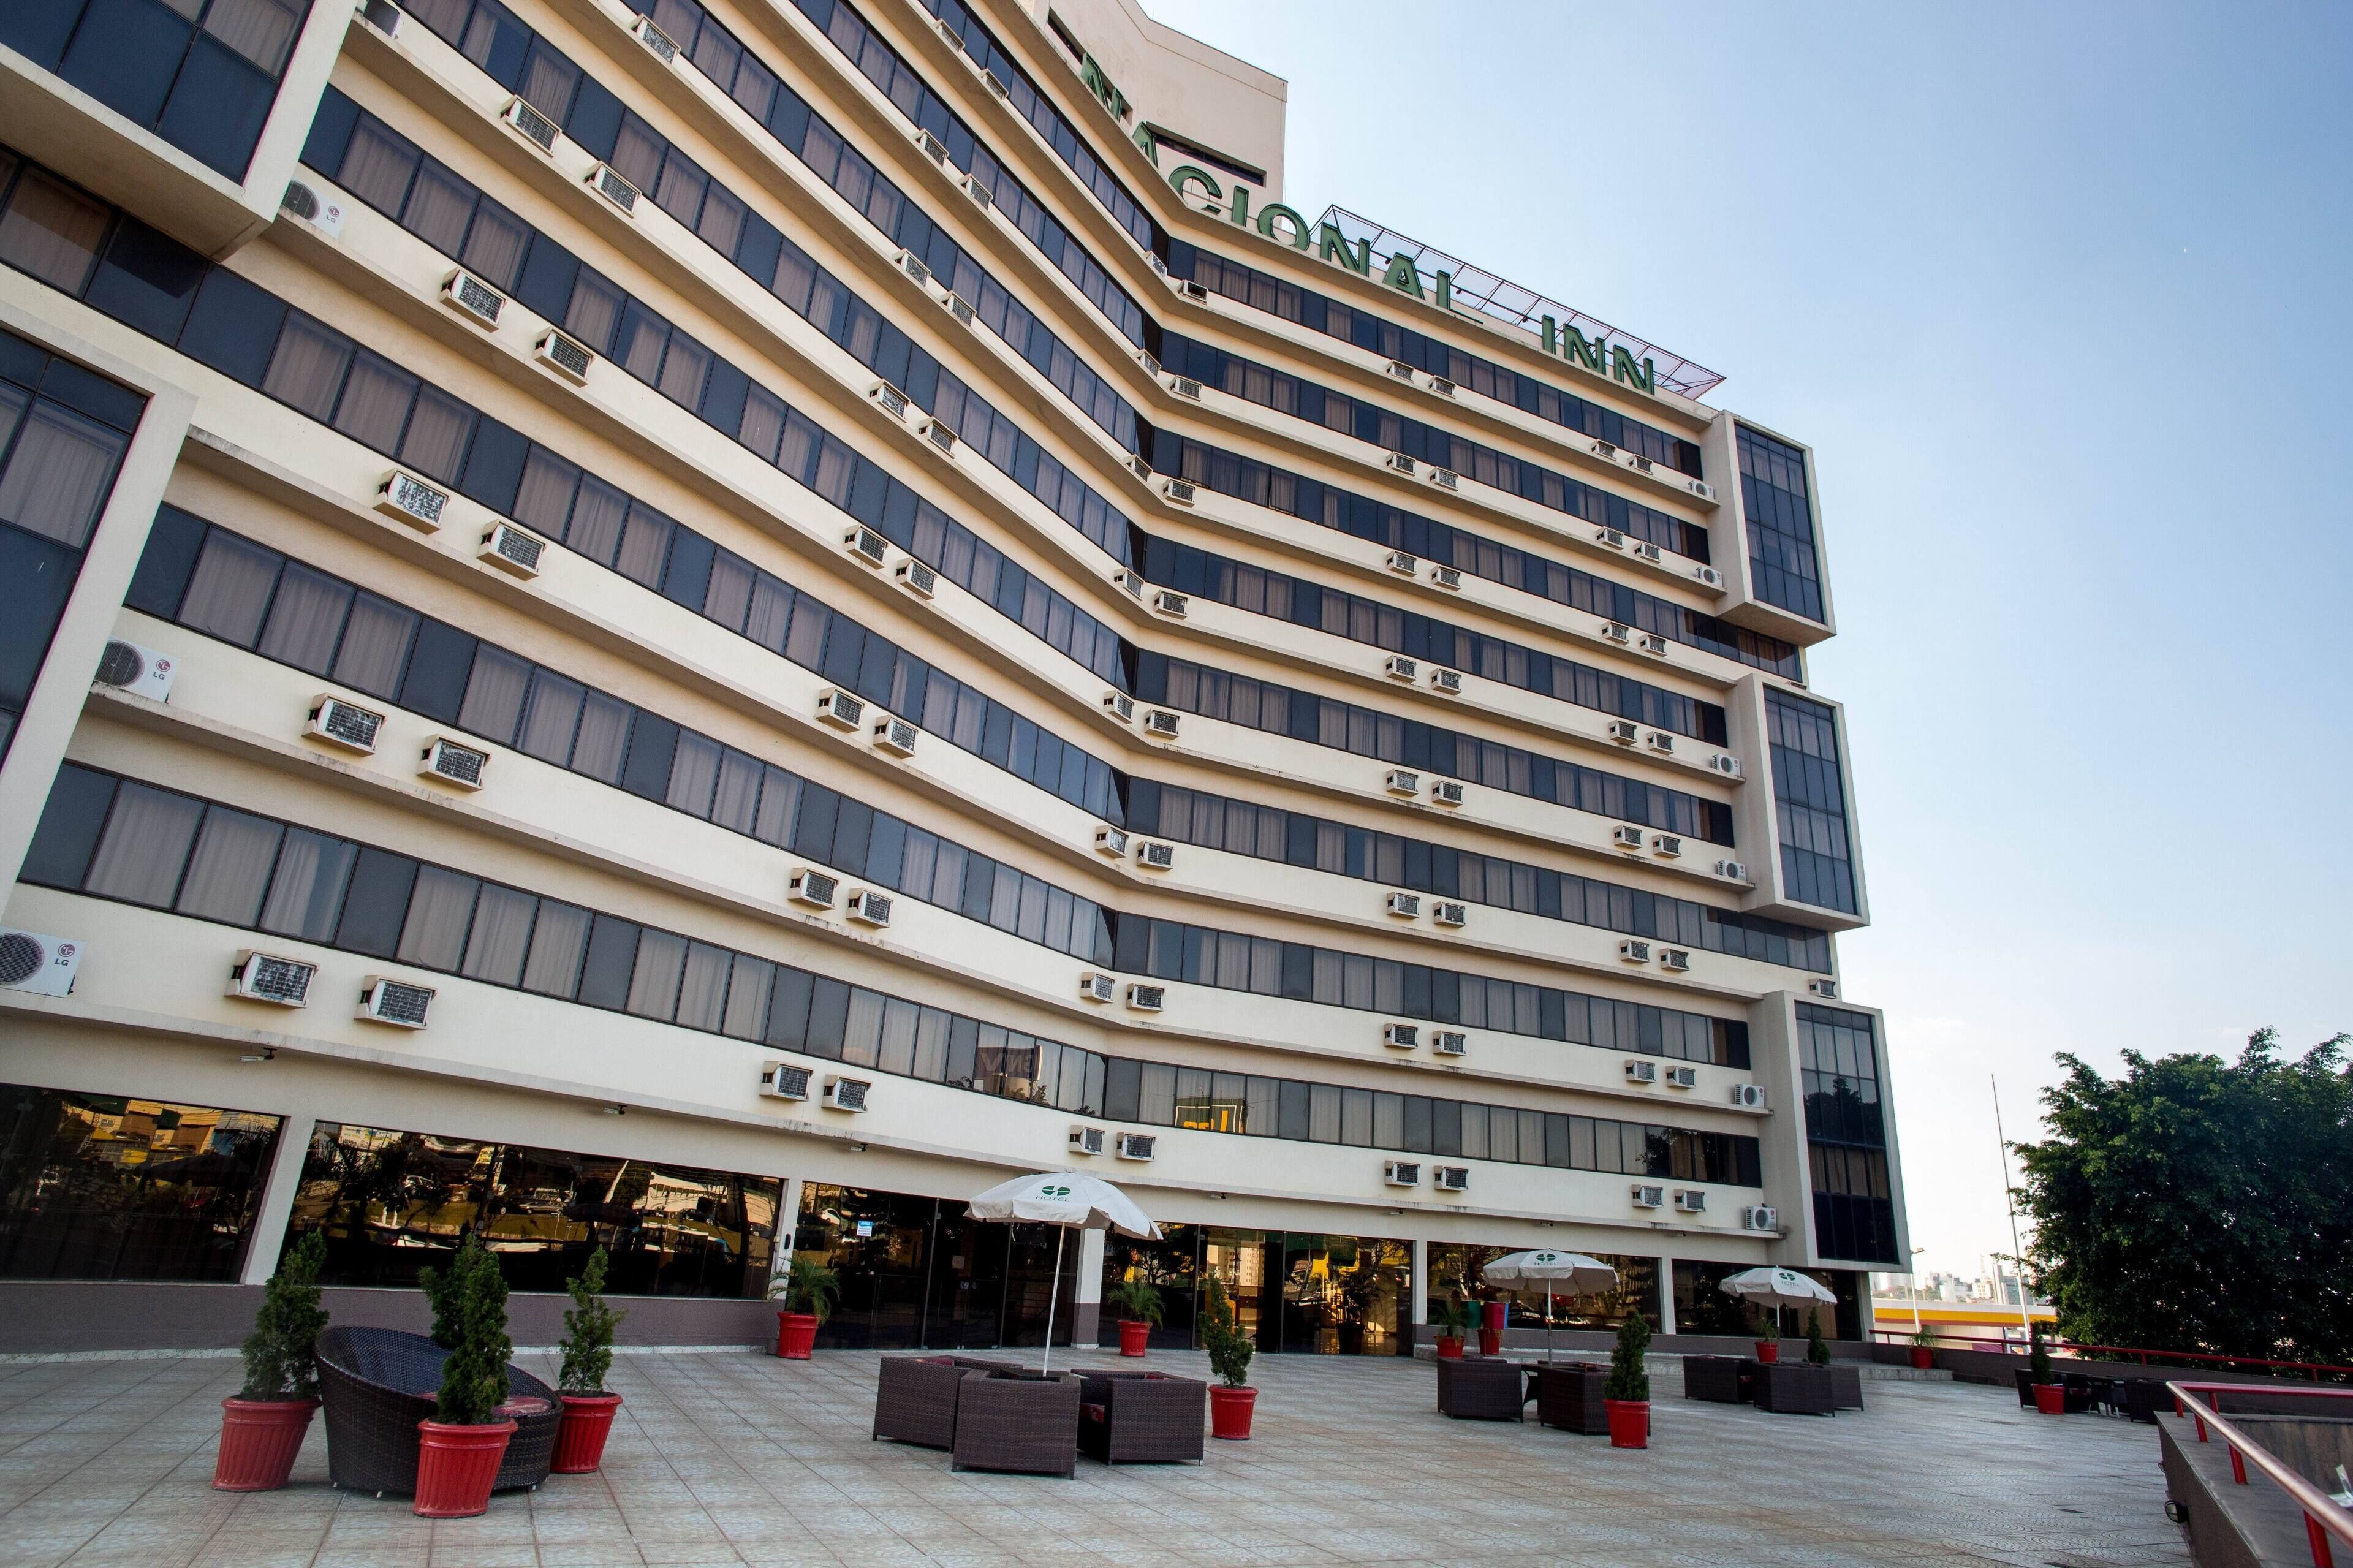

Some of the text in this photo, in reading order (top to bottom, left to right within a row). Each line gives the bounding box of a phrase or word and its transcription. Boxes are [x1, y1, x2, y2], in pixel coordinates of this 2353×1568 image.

[326, 214, 336, 224] LG
[1542, 314, 1655, 395] INN
[153, 671, 165, 680] LG
